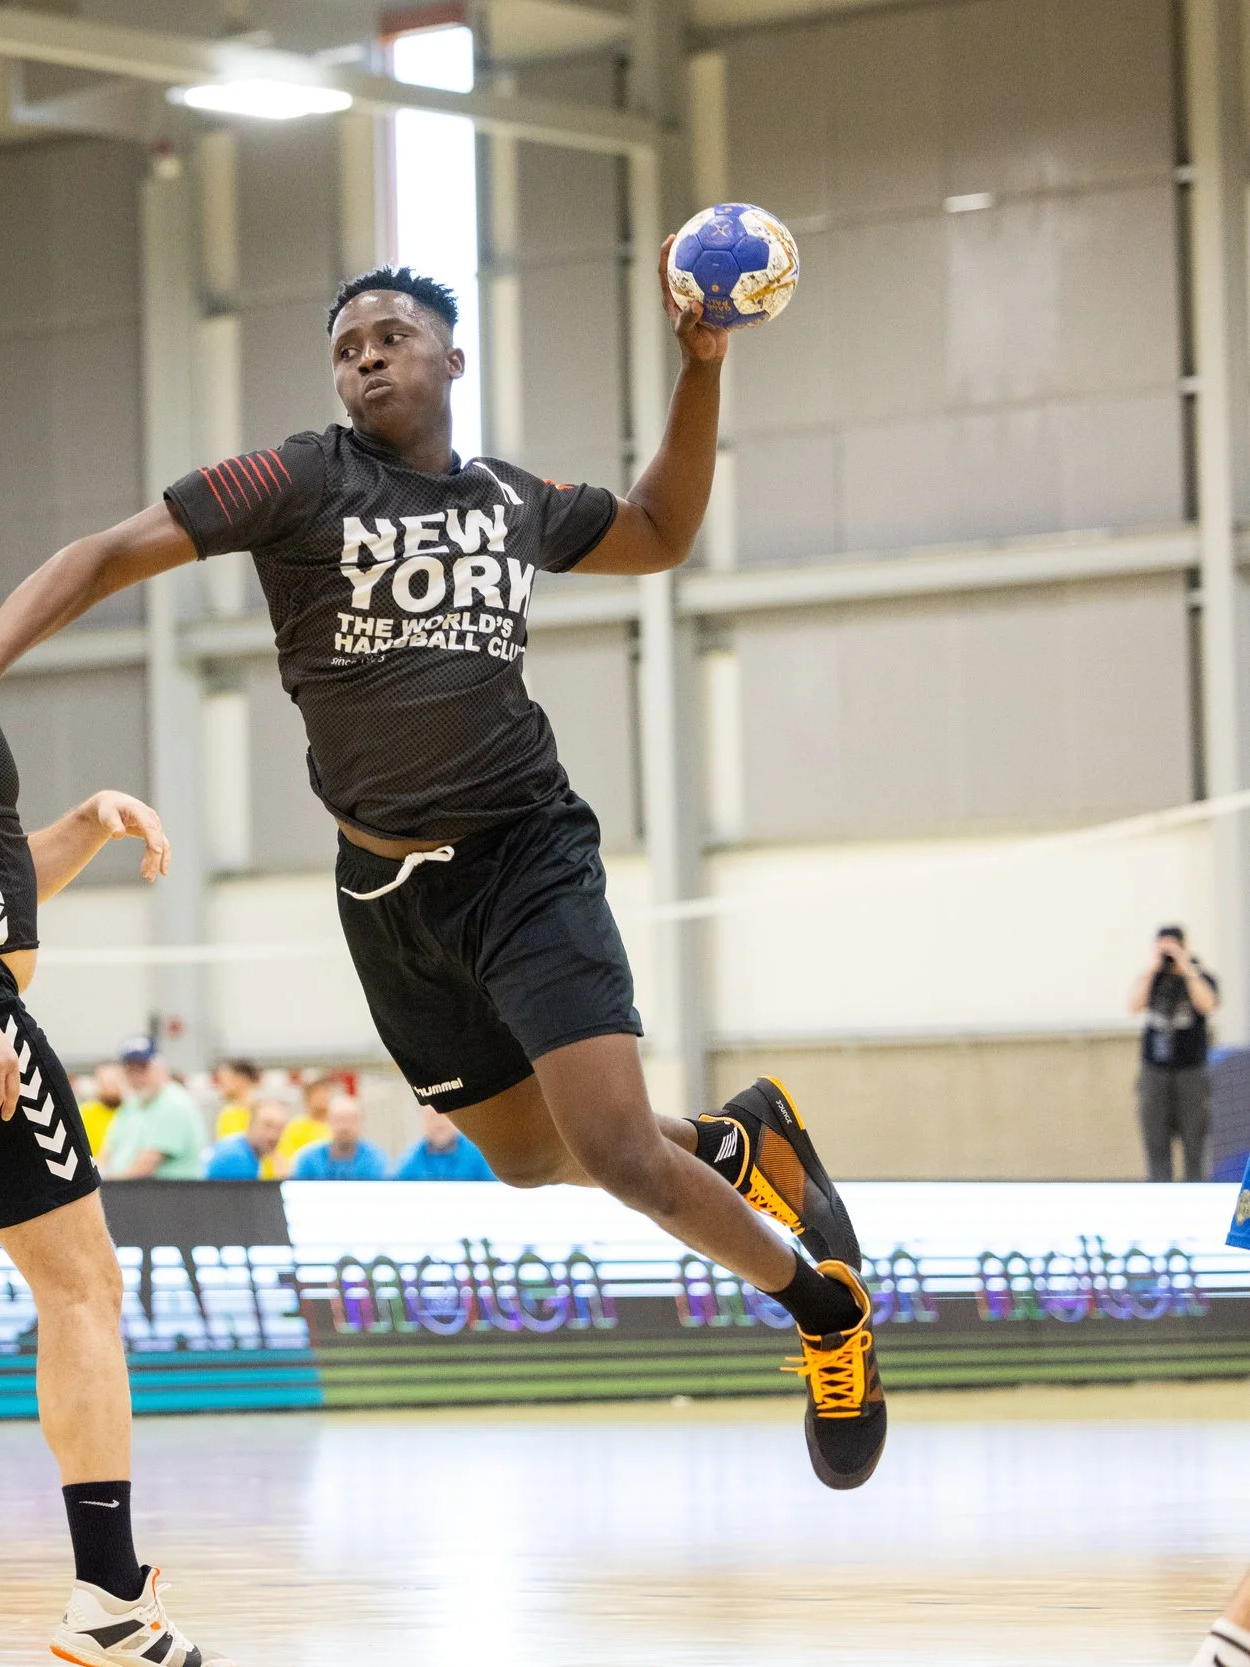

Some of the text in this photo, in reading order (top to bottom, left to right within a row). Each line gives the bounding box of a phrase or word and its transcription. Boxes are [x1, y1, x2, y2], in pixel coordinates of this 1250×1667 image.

[340, 505, 508, 563] NEW
[339, 555, 535, 619] YORK
[337, 612, 514, 639] THE WORLD'S
[487, 637, 526, 663] CLU
[413, 1077, 464, 1097] hummel
